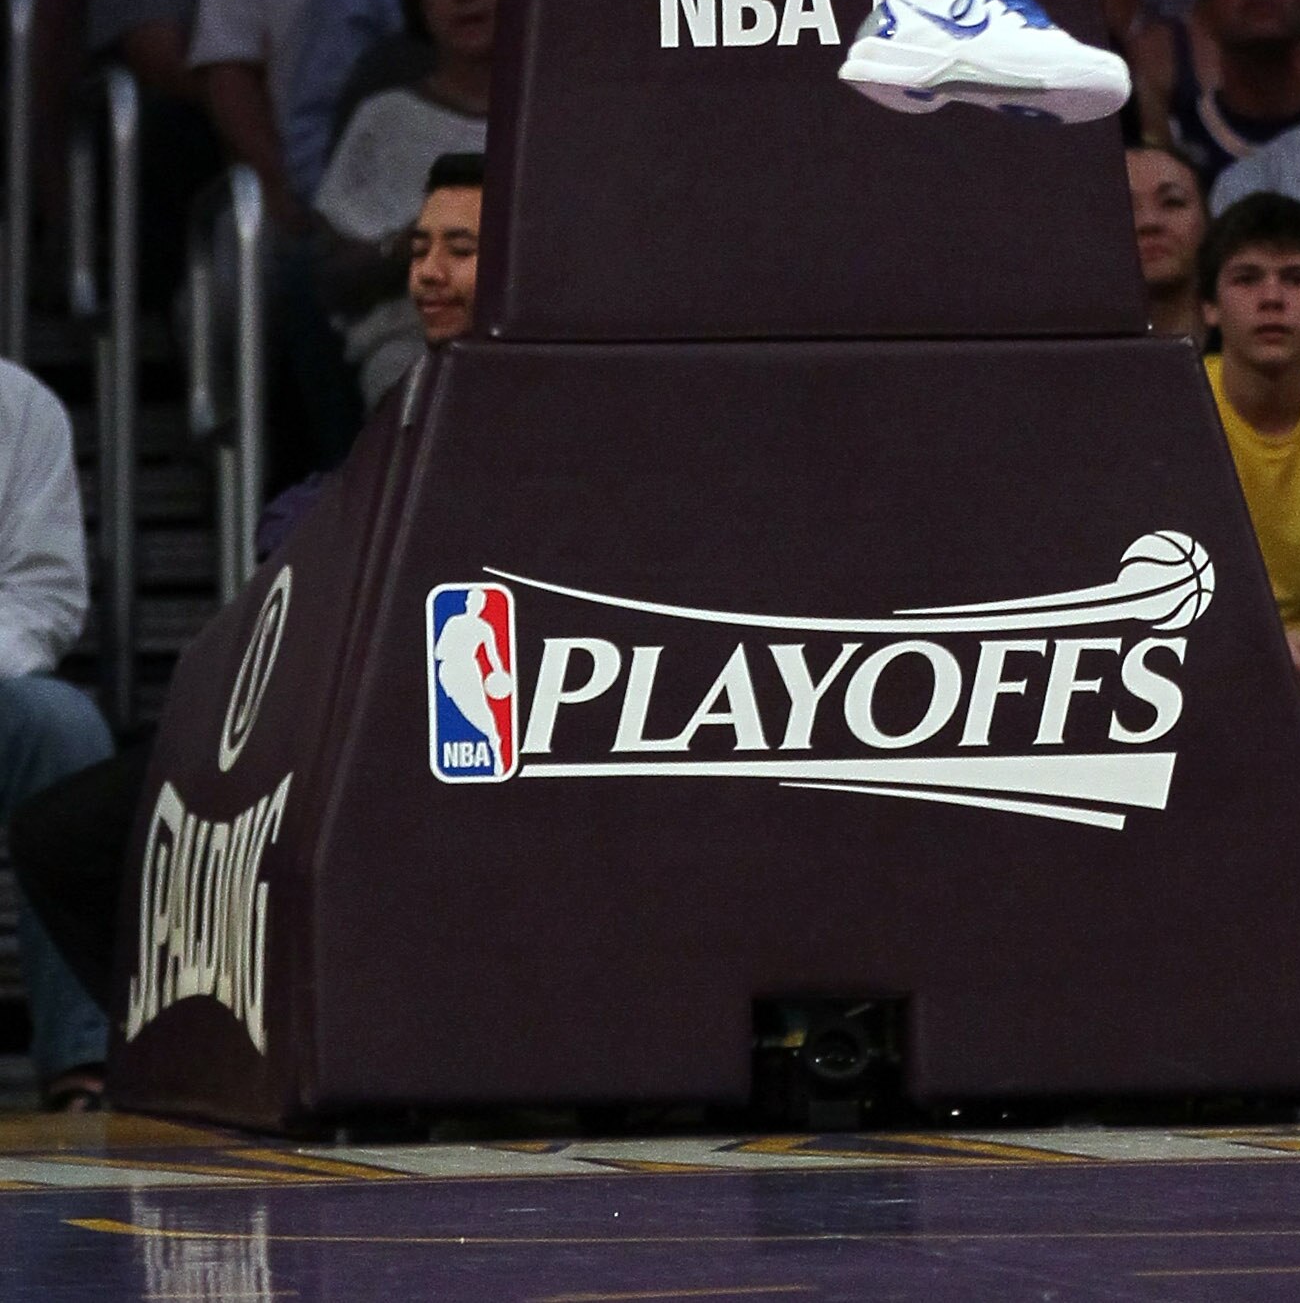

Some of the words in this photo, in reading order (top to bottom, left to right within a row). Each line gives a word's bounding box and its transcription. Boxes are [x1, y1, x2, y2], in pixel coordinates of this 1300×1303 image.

[442, 740, 492, 769] NBA
[519, 635, 1188, 755] PLAYOFFS
[122, 770, 295, 1058] SPALDING
